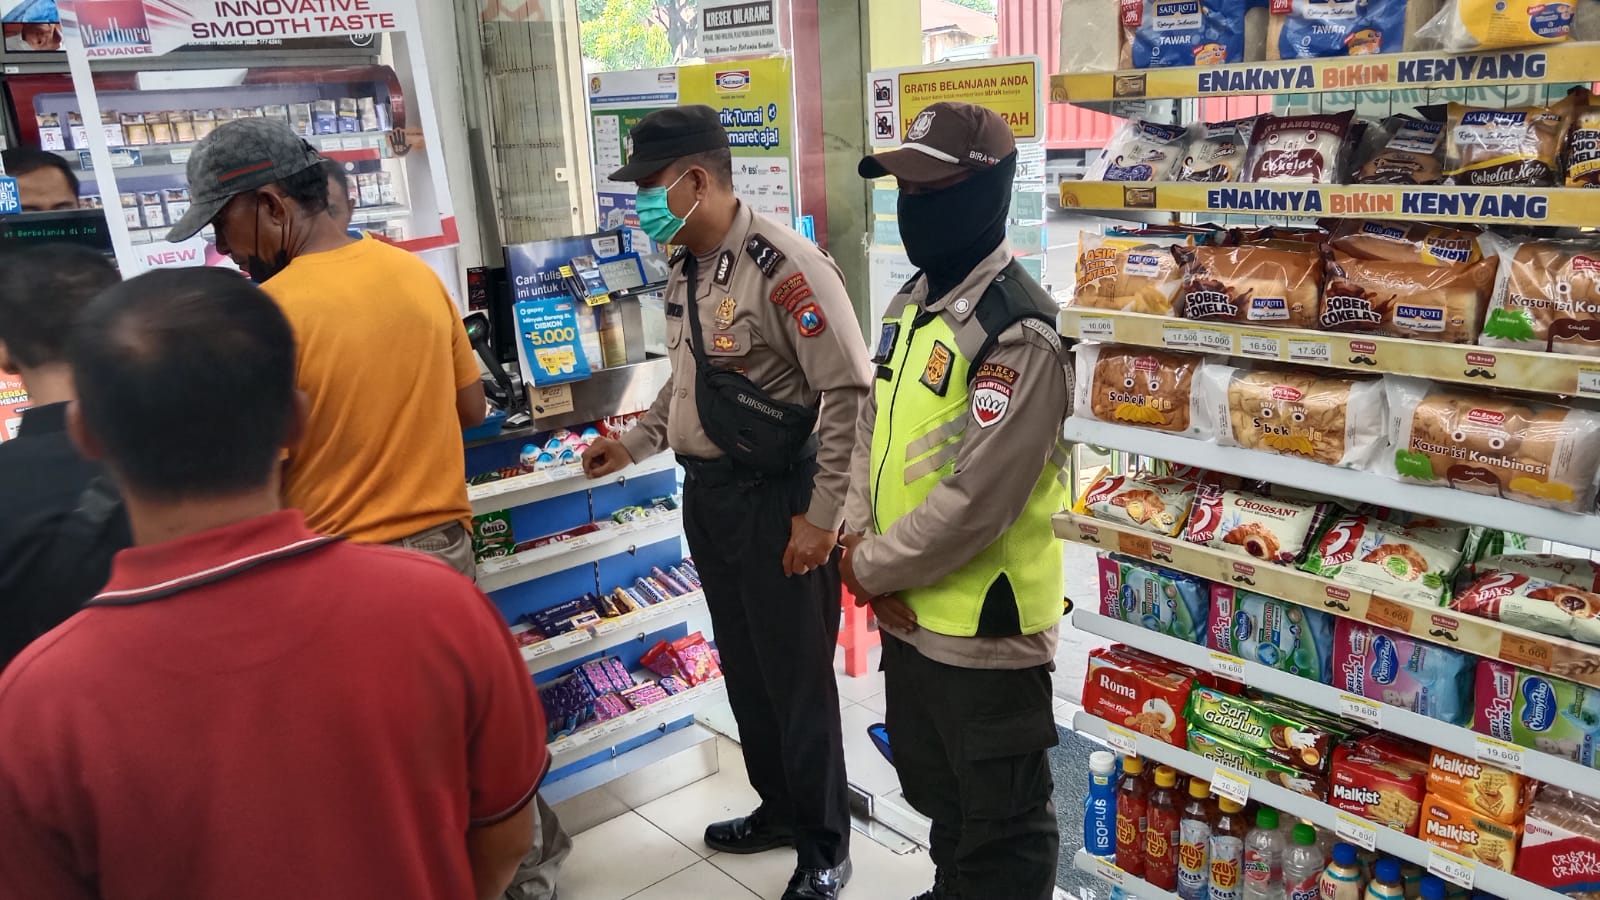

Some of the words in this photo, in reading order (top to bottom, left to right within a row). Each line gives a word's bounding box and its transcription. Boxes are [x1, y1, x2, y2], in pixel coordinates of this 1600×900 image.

[215, 0, 370, 18] INNOVATIVE
[706, 10, 732, 27] KRESEK
[733, 6, 770, 25] DILARANG
[1158, 5, 1176, 14] SARI
[1178, 3, 1197, 13] ROTI
[81, 17, 150, 47] Marlboro
[192, 18, 309, 39] SMOOTH
[316, 13, 395, 32] TASTE
[1312, 25, 1346, 35] TAWAR
[1160, 35, 1191, 46] TAWAR
[86, 45, 153, 57] ADVANCE
[1397, 54, 1546, 83] KENYANG
[904, 82, 937, 94] GRATIS
[940, 78, 998, 91] BELANJAAN
[1000, 75, 1029, 86] ANDA
[984, 89, 1002, 97] struk
[734, 108, 763, 124] Tunai
[1465, 114, 1490, 123] SARI
[760, 128, 779, 147] aja!
[1471, 166, 1514, 185] Cokelat
[1401, 192, 1548, 219] KENYANG
[147, 249, 196, 266] NEW
[1128, 254, 1142, 263] SARI
[516, 274, 537, 286] Cari
[518, 286, 530, 299] ini
[532, 282, 559, 297] untuk
[1187, 291, 1229, 306] SOBEK
[1327, 297, 1370, 313] SOBEK
[1509, 294, 1550, 309] Kasur
[1554, 299, 1572, 312] isi
[1321, 309, 1381, 326] COKELAT
[1398, 307, 1417, 317] SARI
[1421, 309, 1442, 319] ROTI
[534, 321, 563, 329] DISKON
[531, 327, 575, 346] 5.000
[1173, 333, 1198, 342] 17.500
[1203, 335, 1230, 346] 15.000
[1249, 342, 1277, 352] 16.500
[1298, 347, 1327, 356] 17.500
[737, 393, 784, 421] QUIKSILVER
[1109, 391, 1145, 406] Sobek
[1253, 417, 1289, 436] Sbek
[1411, 437, 1449, 457] Kasur
[1452, 446, 1466, 459] isi
[1468, 449, 1547, 475] Kombinasi
[1192, 497, 1220, 534] 5
[1234, 497, 1300, 518] CROISSANT
[1326, 520, 1358, 556] 5
[1323, 552, 1353, 566] DAYS
[1478, 587, 1513, 602] DAYS
[1384, 608, 1409, 624] 5.000
[1519, 645, 1548, 660] 5.000
[1218, 663, 1243, 674] 19.600
[1377, 640, 1391, 685] MamyPoko
[1100, 674, 1137, 700] Roma
[1219, 702, 1251, 720] Sari
[1349, 704, 1378, 717] 19.600
[1530, 682, 1548, 732] MamyPoko
[1203, 709, 1264, 738] Gandum
[1502, 711, 1512, 742] GRATIS
[1214, 746, 1245, 765] Sari
[1487, 747, 1520, 762] 19.600
[1432, 753, 1482, 778] Malkist
[1333, 785, 1380, 805] Malkist
[1431, 807, 1449, 820] Roma
[1096, 798, 1109, 848] ISOPLUS
[1426, 820, 1479, 844] Malkist
[1180, 842, 1204, 859] FRUIT
[1552, 851, 1597, 866] CRISPY
[1180, 856, 1203, 871] TEA
[1211, 862, 1237, 877] FRUIT
[1212, 873, 1237, 887] TEA
